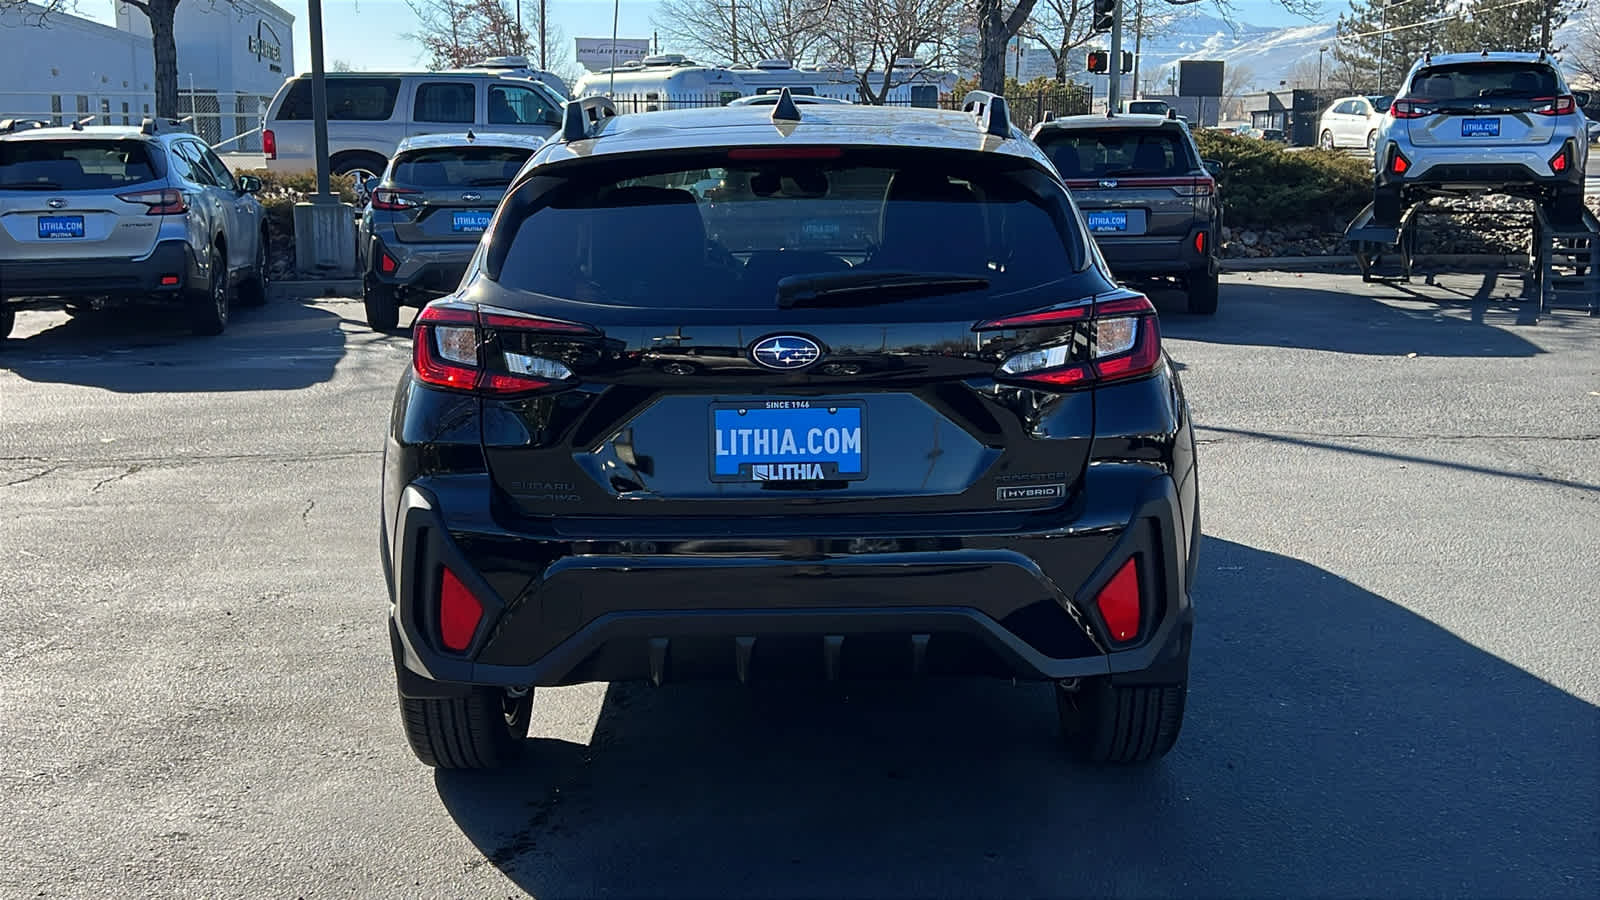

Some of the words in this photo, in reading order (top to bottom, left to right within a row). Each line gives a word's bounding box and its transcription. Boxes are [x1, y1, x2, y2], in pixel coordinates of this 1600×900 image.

[1089, 216, 1126, 225] LITHIA.COM
[40, 222, 82, 231] LITHIA.COM
[766, 401, 790, 409] SINCE
[715, 427, 861, 456] LITHIA.COM
[768, 463, 825, 481] LITHIA
[1008, 488, 1055, 497] HYBRID
